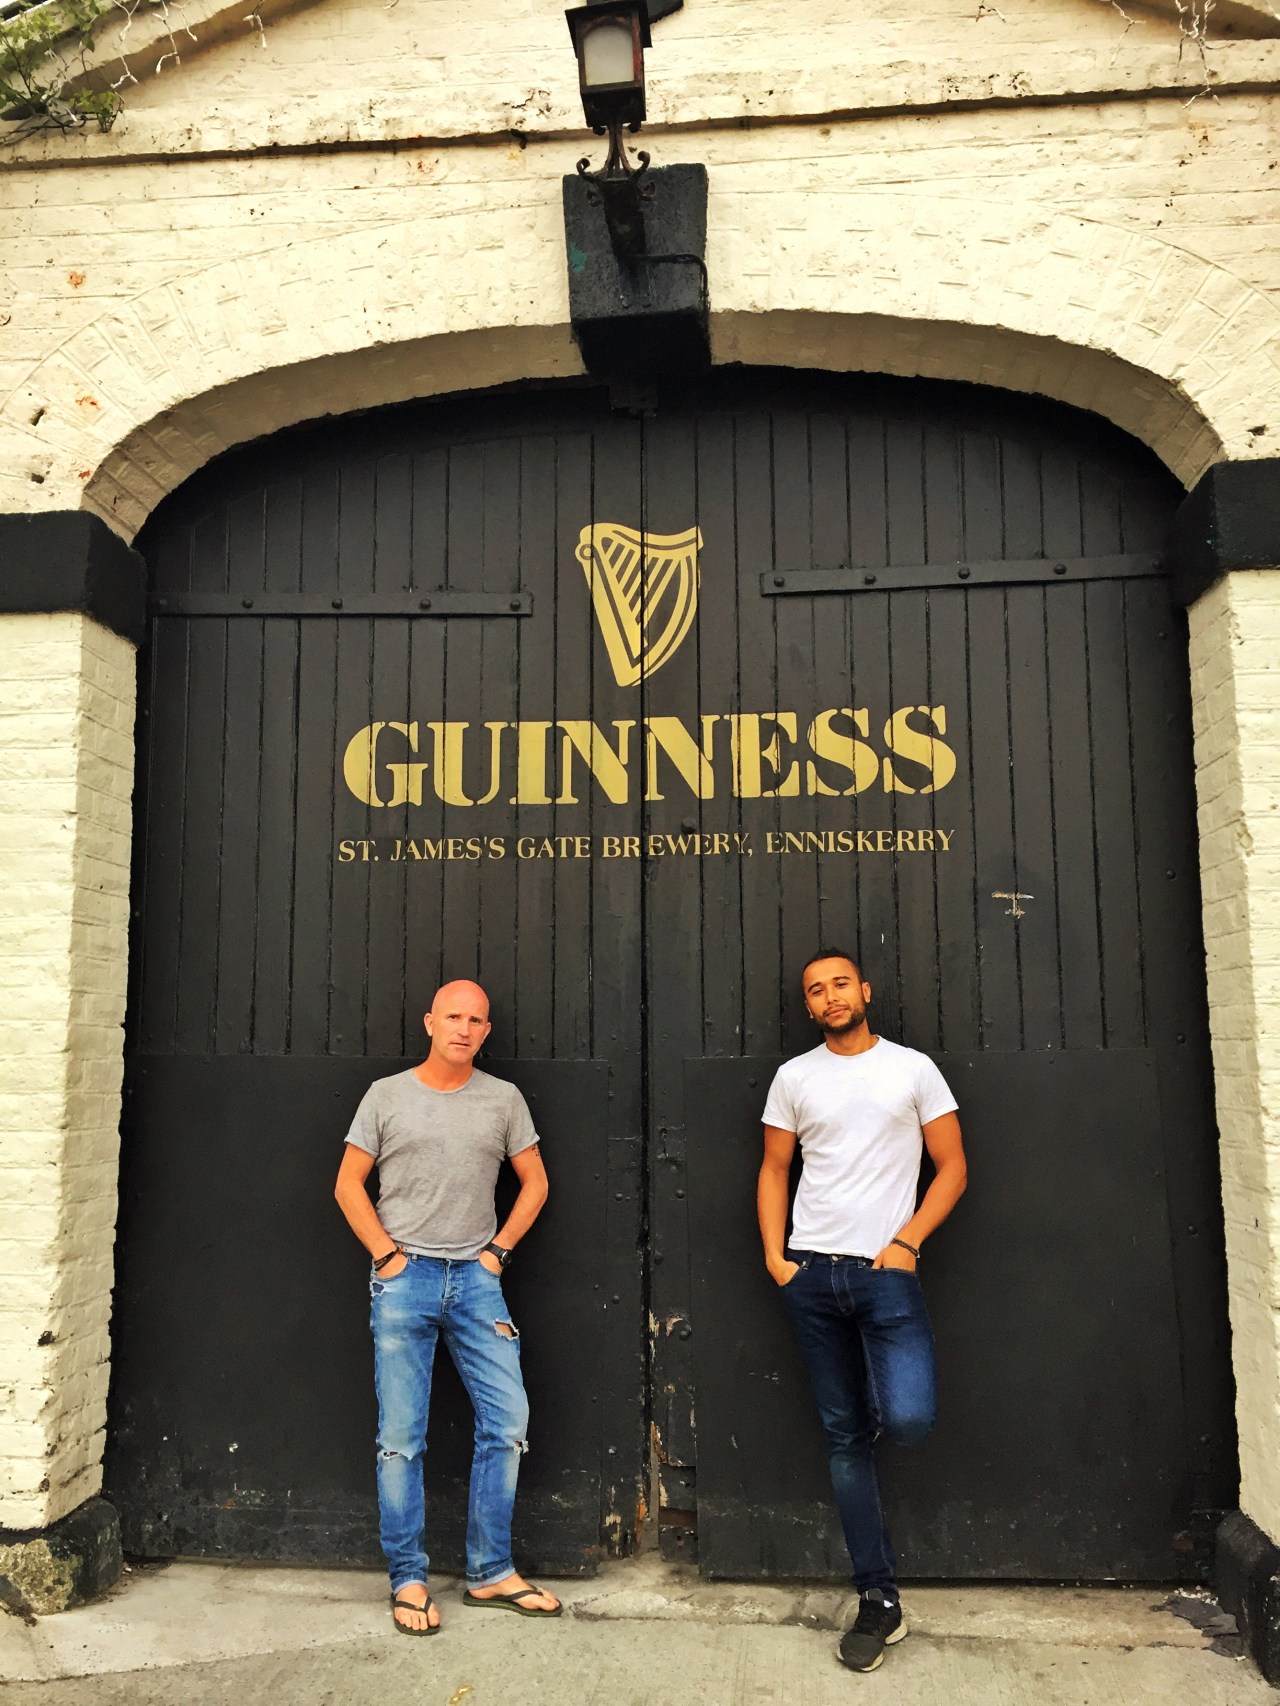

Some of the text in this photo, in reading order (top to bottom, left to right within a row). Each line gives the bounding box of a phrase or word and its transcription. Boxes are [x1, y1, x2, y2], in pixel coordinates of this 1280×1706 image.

[342, 705, 957, 807] GUINNESS
[338, 829, 956, 862] ST. JAMES'S GATE BREWERY, ENNISKERRY
